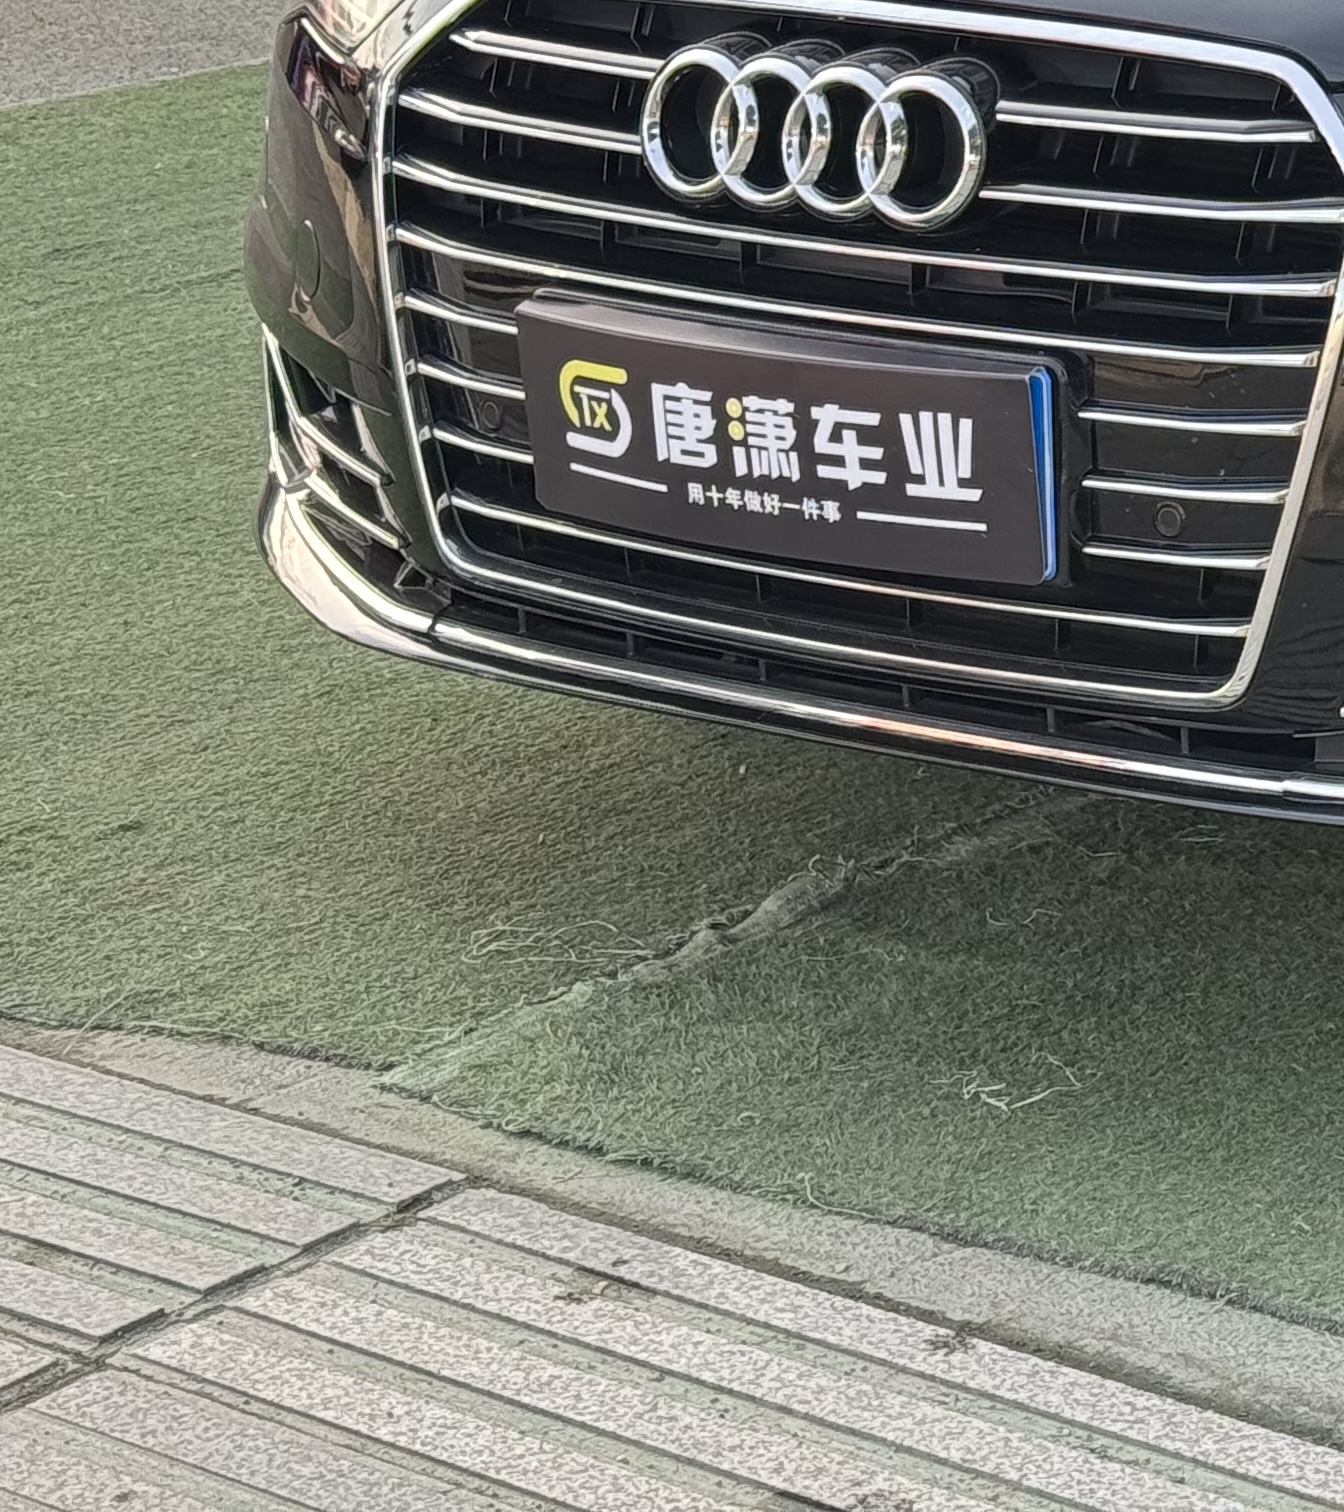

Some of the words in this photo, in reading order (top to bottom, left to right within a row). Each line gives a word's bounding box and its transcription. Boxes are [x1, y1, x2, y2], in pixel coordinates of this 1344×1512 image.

[650, 382, 984, 501] 唐潇车业
[687, 482, 842, 524] 用十年做好一件事
